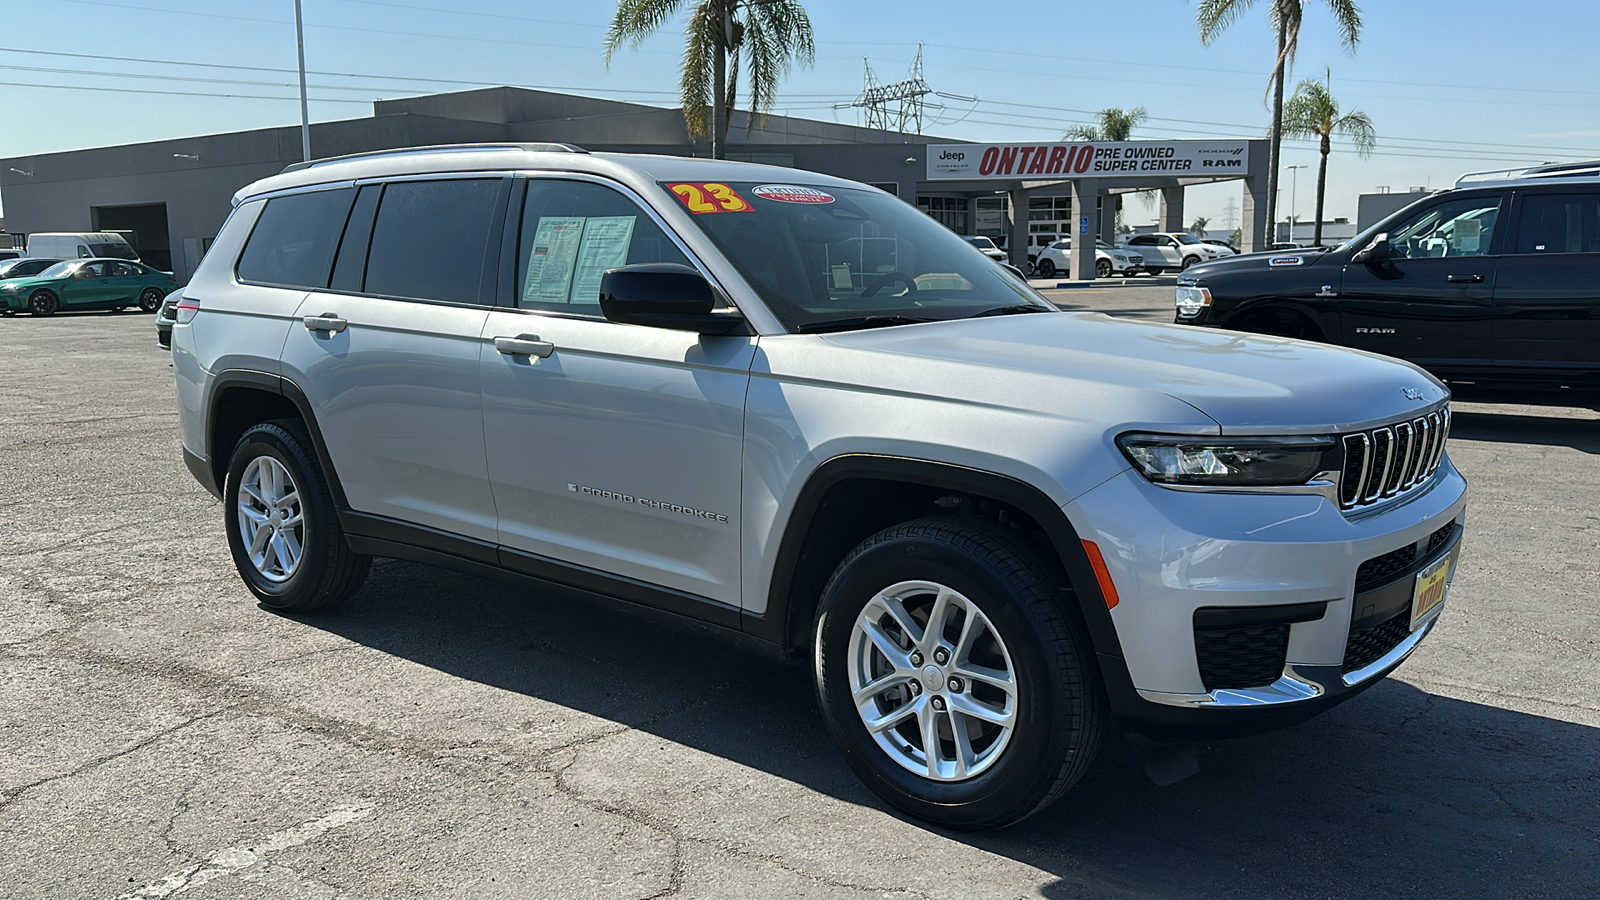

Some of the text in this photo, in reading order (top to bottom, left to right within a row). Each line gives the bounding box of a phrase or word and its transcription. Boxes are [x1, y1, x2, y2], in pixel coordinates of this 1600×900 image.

[939, 150, 965, 161] Jeep
[979, 145, 1095, 176] ONTARIO
[1094, 147, 1175, 159] PRE OWNED
[1094, 159, 1192, 172] SUPER CENTER
[672, 183, 746, 212] 23
[582, 486, 728, 524] GRAND CHEROKEE
